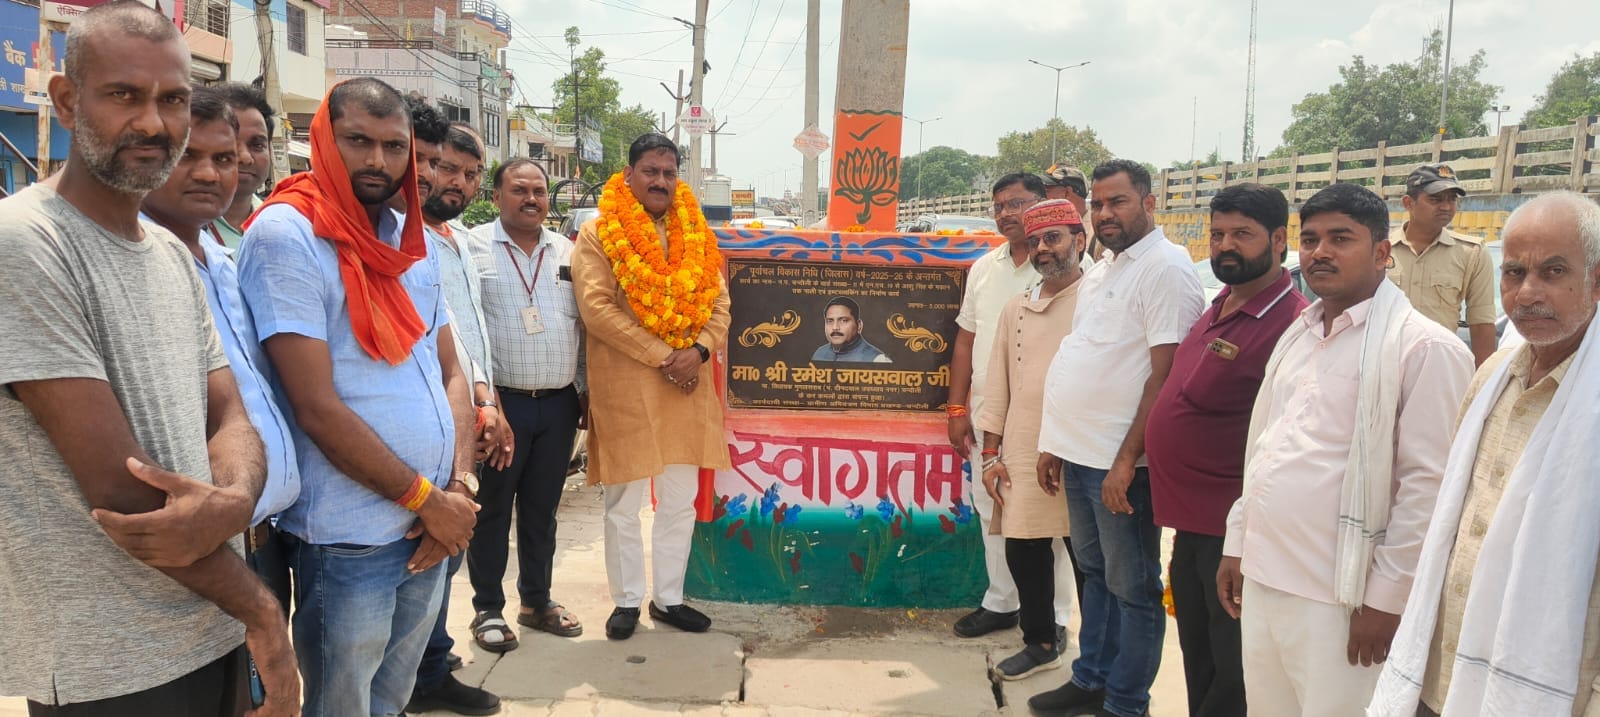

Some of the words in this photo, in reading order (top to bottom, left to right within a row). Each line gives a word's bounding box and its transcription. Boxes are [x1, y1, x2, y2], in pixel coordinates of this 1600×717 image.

[777, 266, 800, 277] विकास
[802, 267, 818, 278] निधि
[764, 361, 788, 382] श्री
[791, 363, 833, 383] रमेश
[836, 369, 924, 386] जायसवाल
[926, 365, 951, 386] जी
[728, 430, 963, 524] स्वागतम
